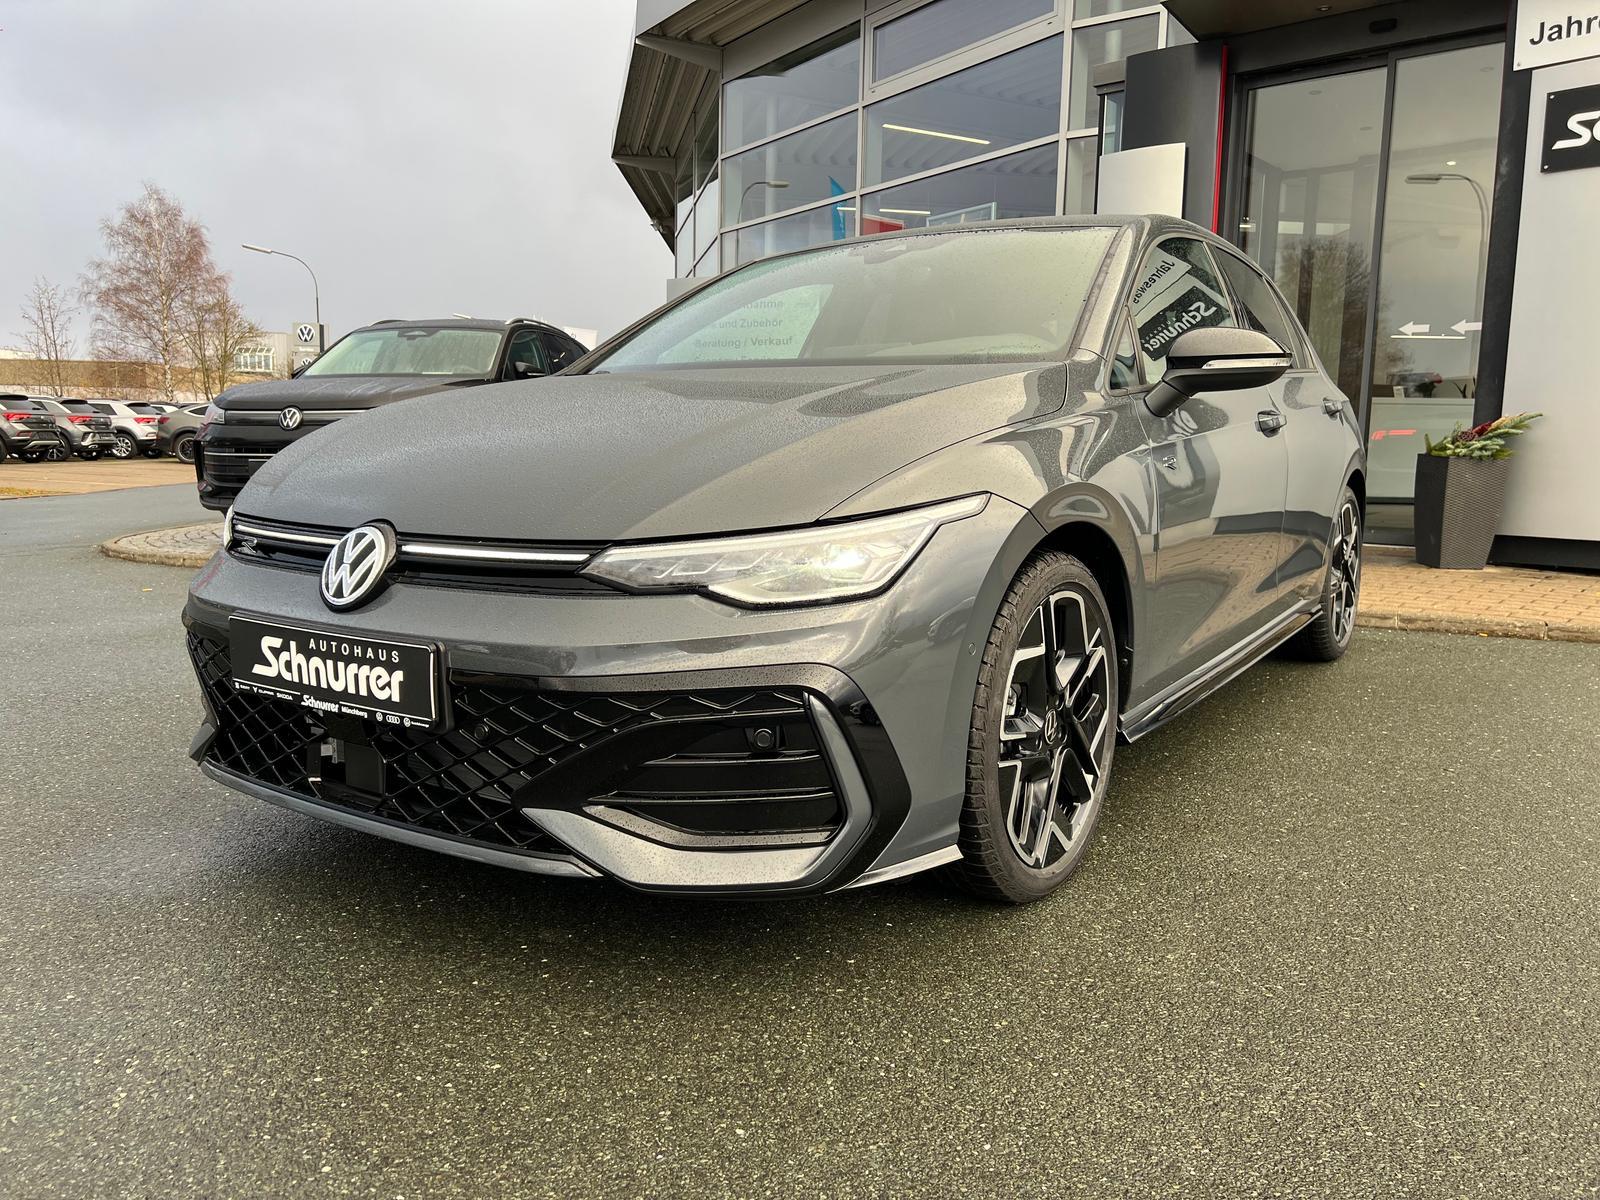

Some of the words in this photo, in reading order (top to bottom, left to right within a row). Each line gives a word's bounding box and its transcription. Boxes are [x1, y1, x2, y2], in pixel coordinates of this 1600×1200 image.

[1529, 15, 1600, 46] Jahr
[750, 335, 793, 347] Verkauf
[308, 638, 400, 664] AUTOHAUS
[252, 635, 404, 703] Schnurrer
[301, 694, 339, 713] Schnurrer
